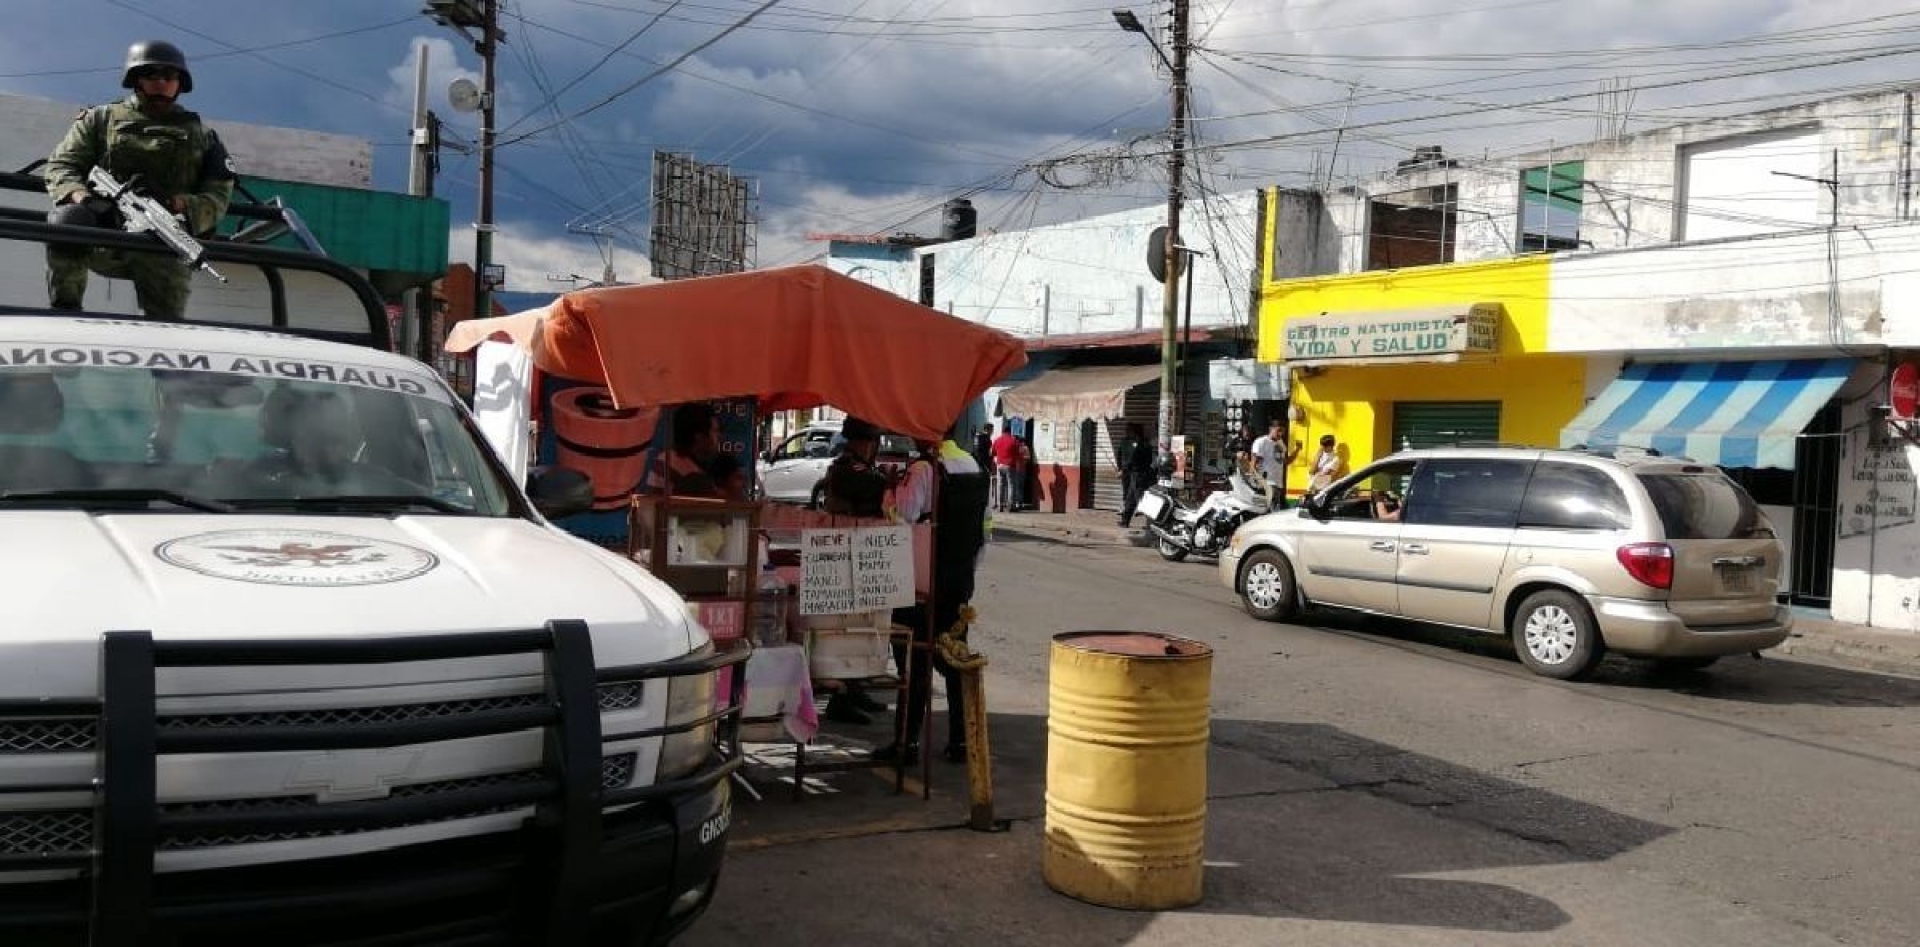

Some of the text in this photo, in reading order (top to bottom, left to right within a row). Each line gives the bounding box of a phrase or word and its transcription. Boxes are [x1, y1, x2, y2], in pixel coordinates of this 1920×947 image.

[1358, 319, 1454, 335] NATURISTA
[1350, 338, 1361, 353] Y
[811, 534, 844, 547] NIEVE
[865, 533, 898, 547] NIEVE
